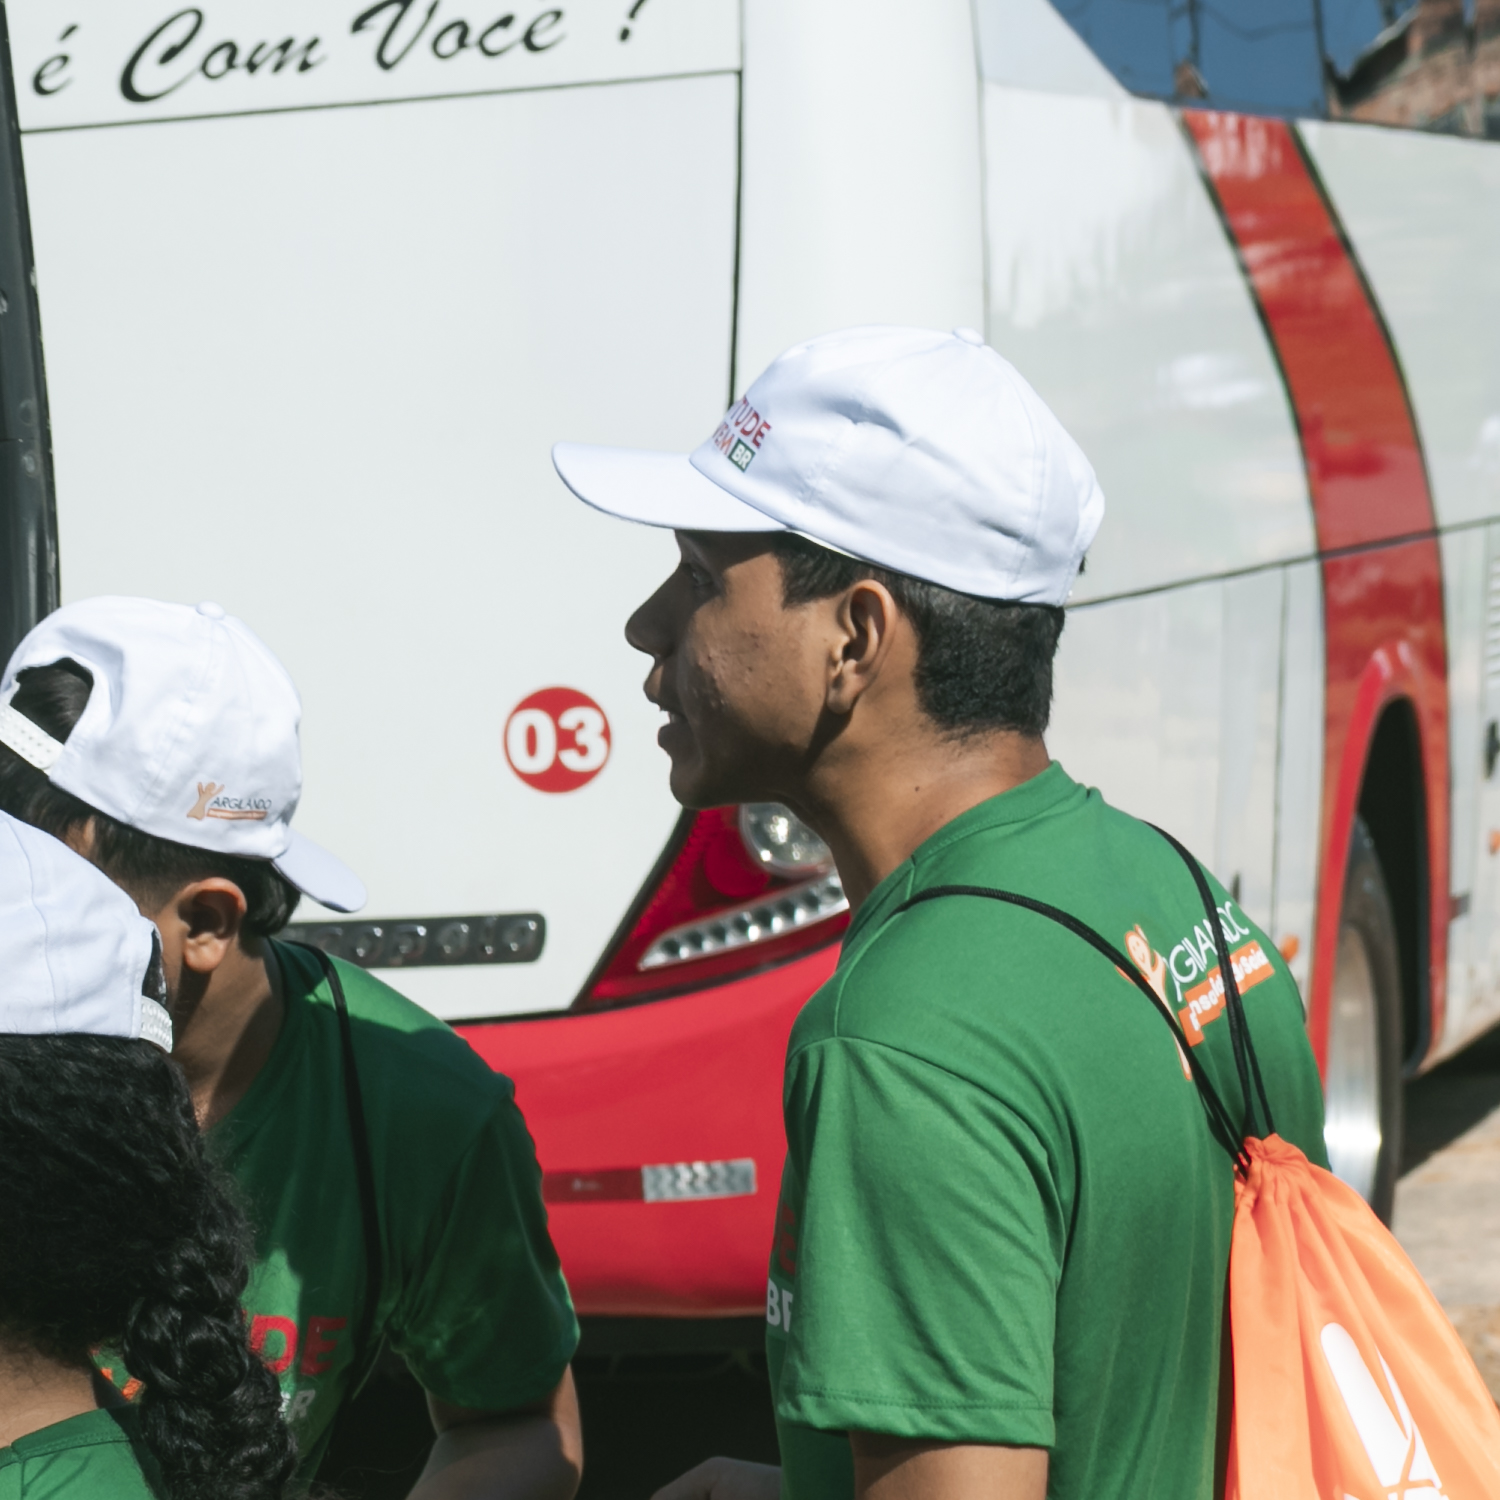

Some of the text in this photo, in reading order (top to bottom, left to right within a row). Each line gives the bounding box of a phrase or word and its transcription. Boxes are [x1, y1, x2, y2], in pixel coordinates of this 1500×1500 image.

[32, 23, 80, 96] é
[119, 7, 326, 102] Com
[730, 442, 754, 470] BR
[505, 706, 609, 775] 03
